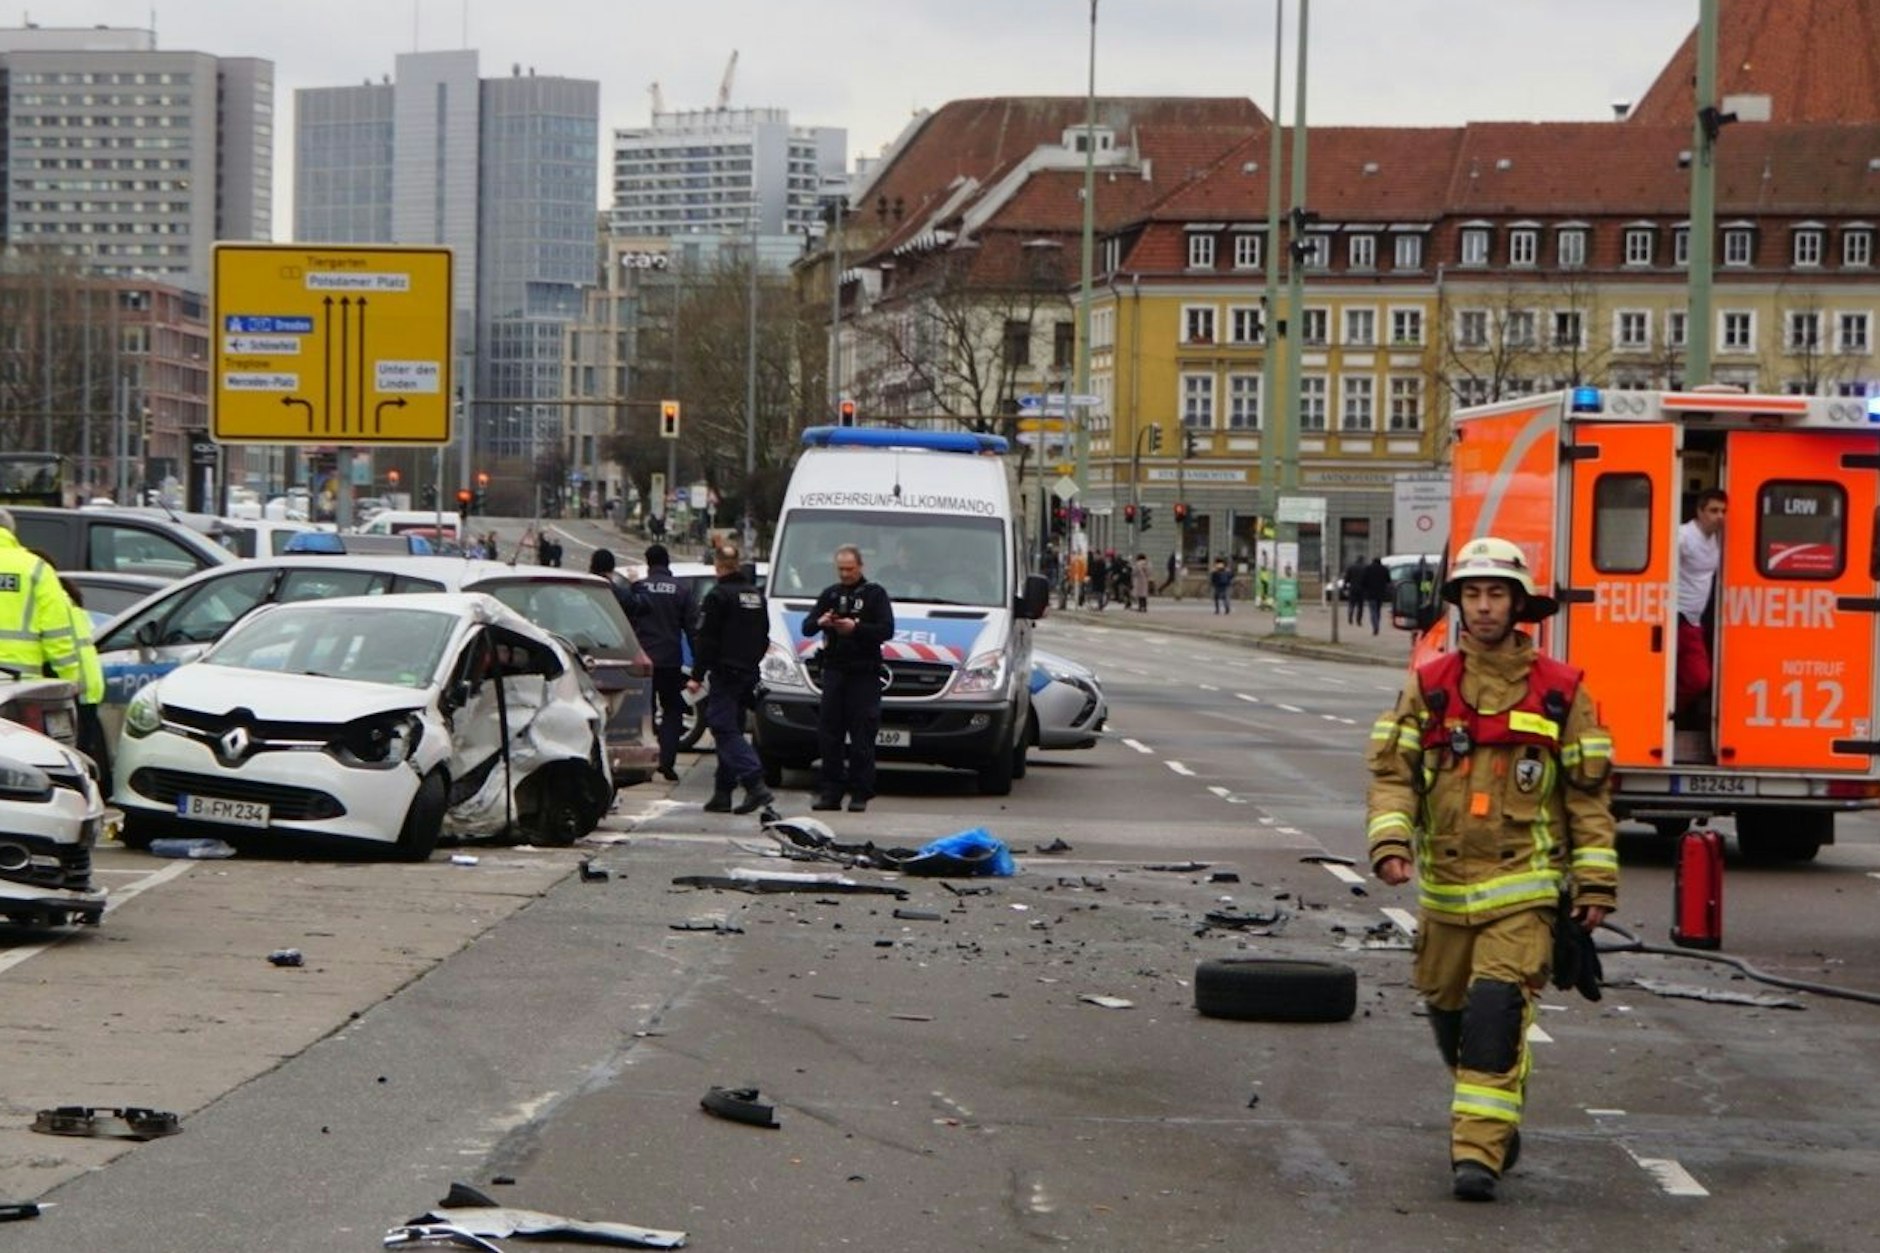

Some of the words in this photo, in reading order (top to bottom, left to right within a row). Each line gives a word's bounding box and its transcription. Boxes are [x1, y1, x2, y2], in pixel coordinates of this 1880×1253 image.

[307, 256, 367, 270] Tiergarten
[308, 275, 372, 287] Potsdamer
[377, 276, 407, 289] Platz
[378, 363, 410, 375] Unter
[415, 364, 437, 376] den
[378, 379, 418, 390] Linden
[799, 492, 996, 516] VERKEHRSUNFALLKOMMANDO
[1784, 497, 1818, 516] LRW
[1781, 660, 1846, 677] NOTRUF
[1745, 678, 1845, 729] 112
[878, 731, 900, 743] 169
